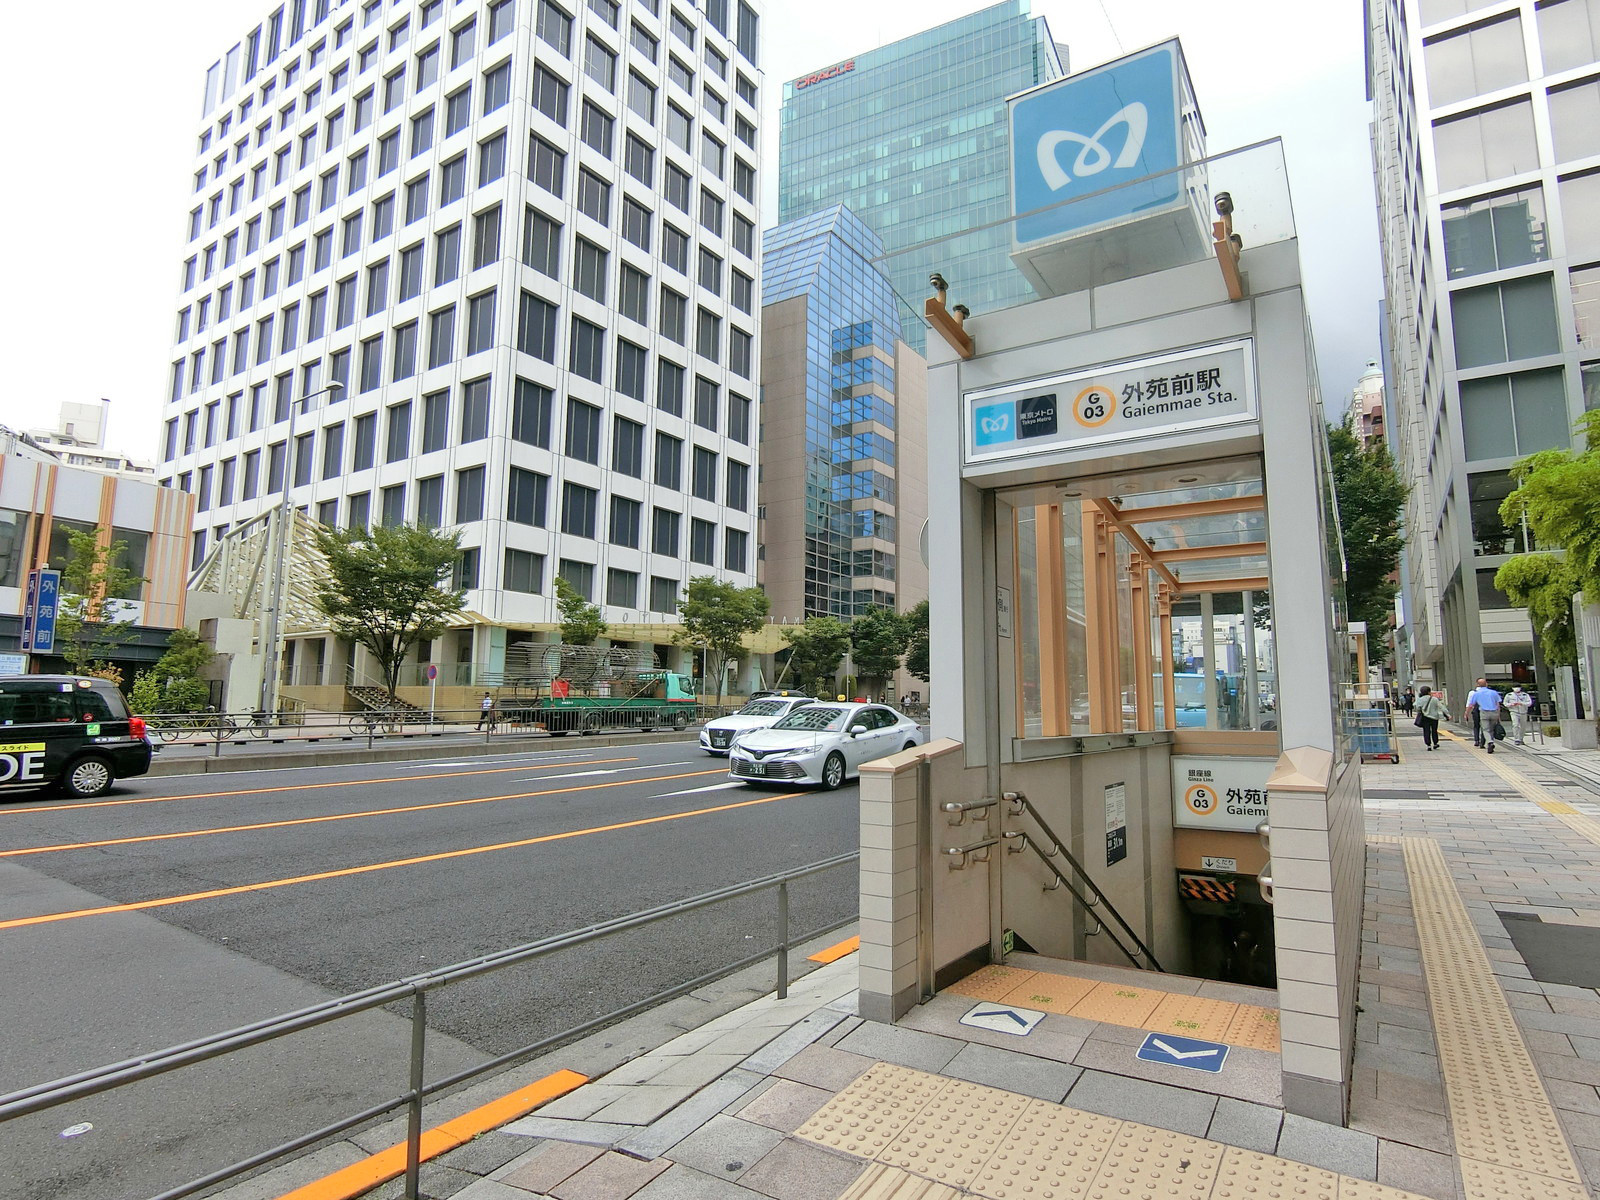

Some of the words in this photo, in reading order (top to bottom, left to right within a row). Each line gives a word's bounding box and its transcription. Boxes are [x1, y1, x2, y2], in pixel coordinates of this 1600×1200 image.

[795, 60, 855, 90] ORACLE
[1121, 367, 1221, 404] 外苑前駅
[1088, 393, 1100, 404] G
[1122, 397, 1202, 419] Gaiemmae
[1207, 391, 1238, 405] Sta.
[1020, 408, 1054, 420] 東京メトロ
[1084, 405, 1104, 419] 03
[37, 580, 55, 644] 外苑前
[1188, 769, 1212, 777] 銀座線
[1197, 789, 1206, 798] G
[1193, 799, 1209, 808] 03
